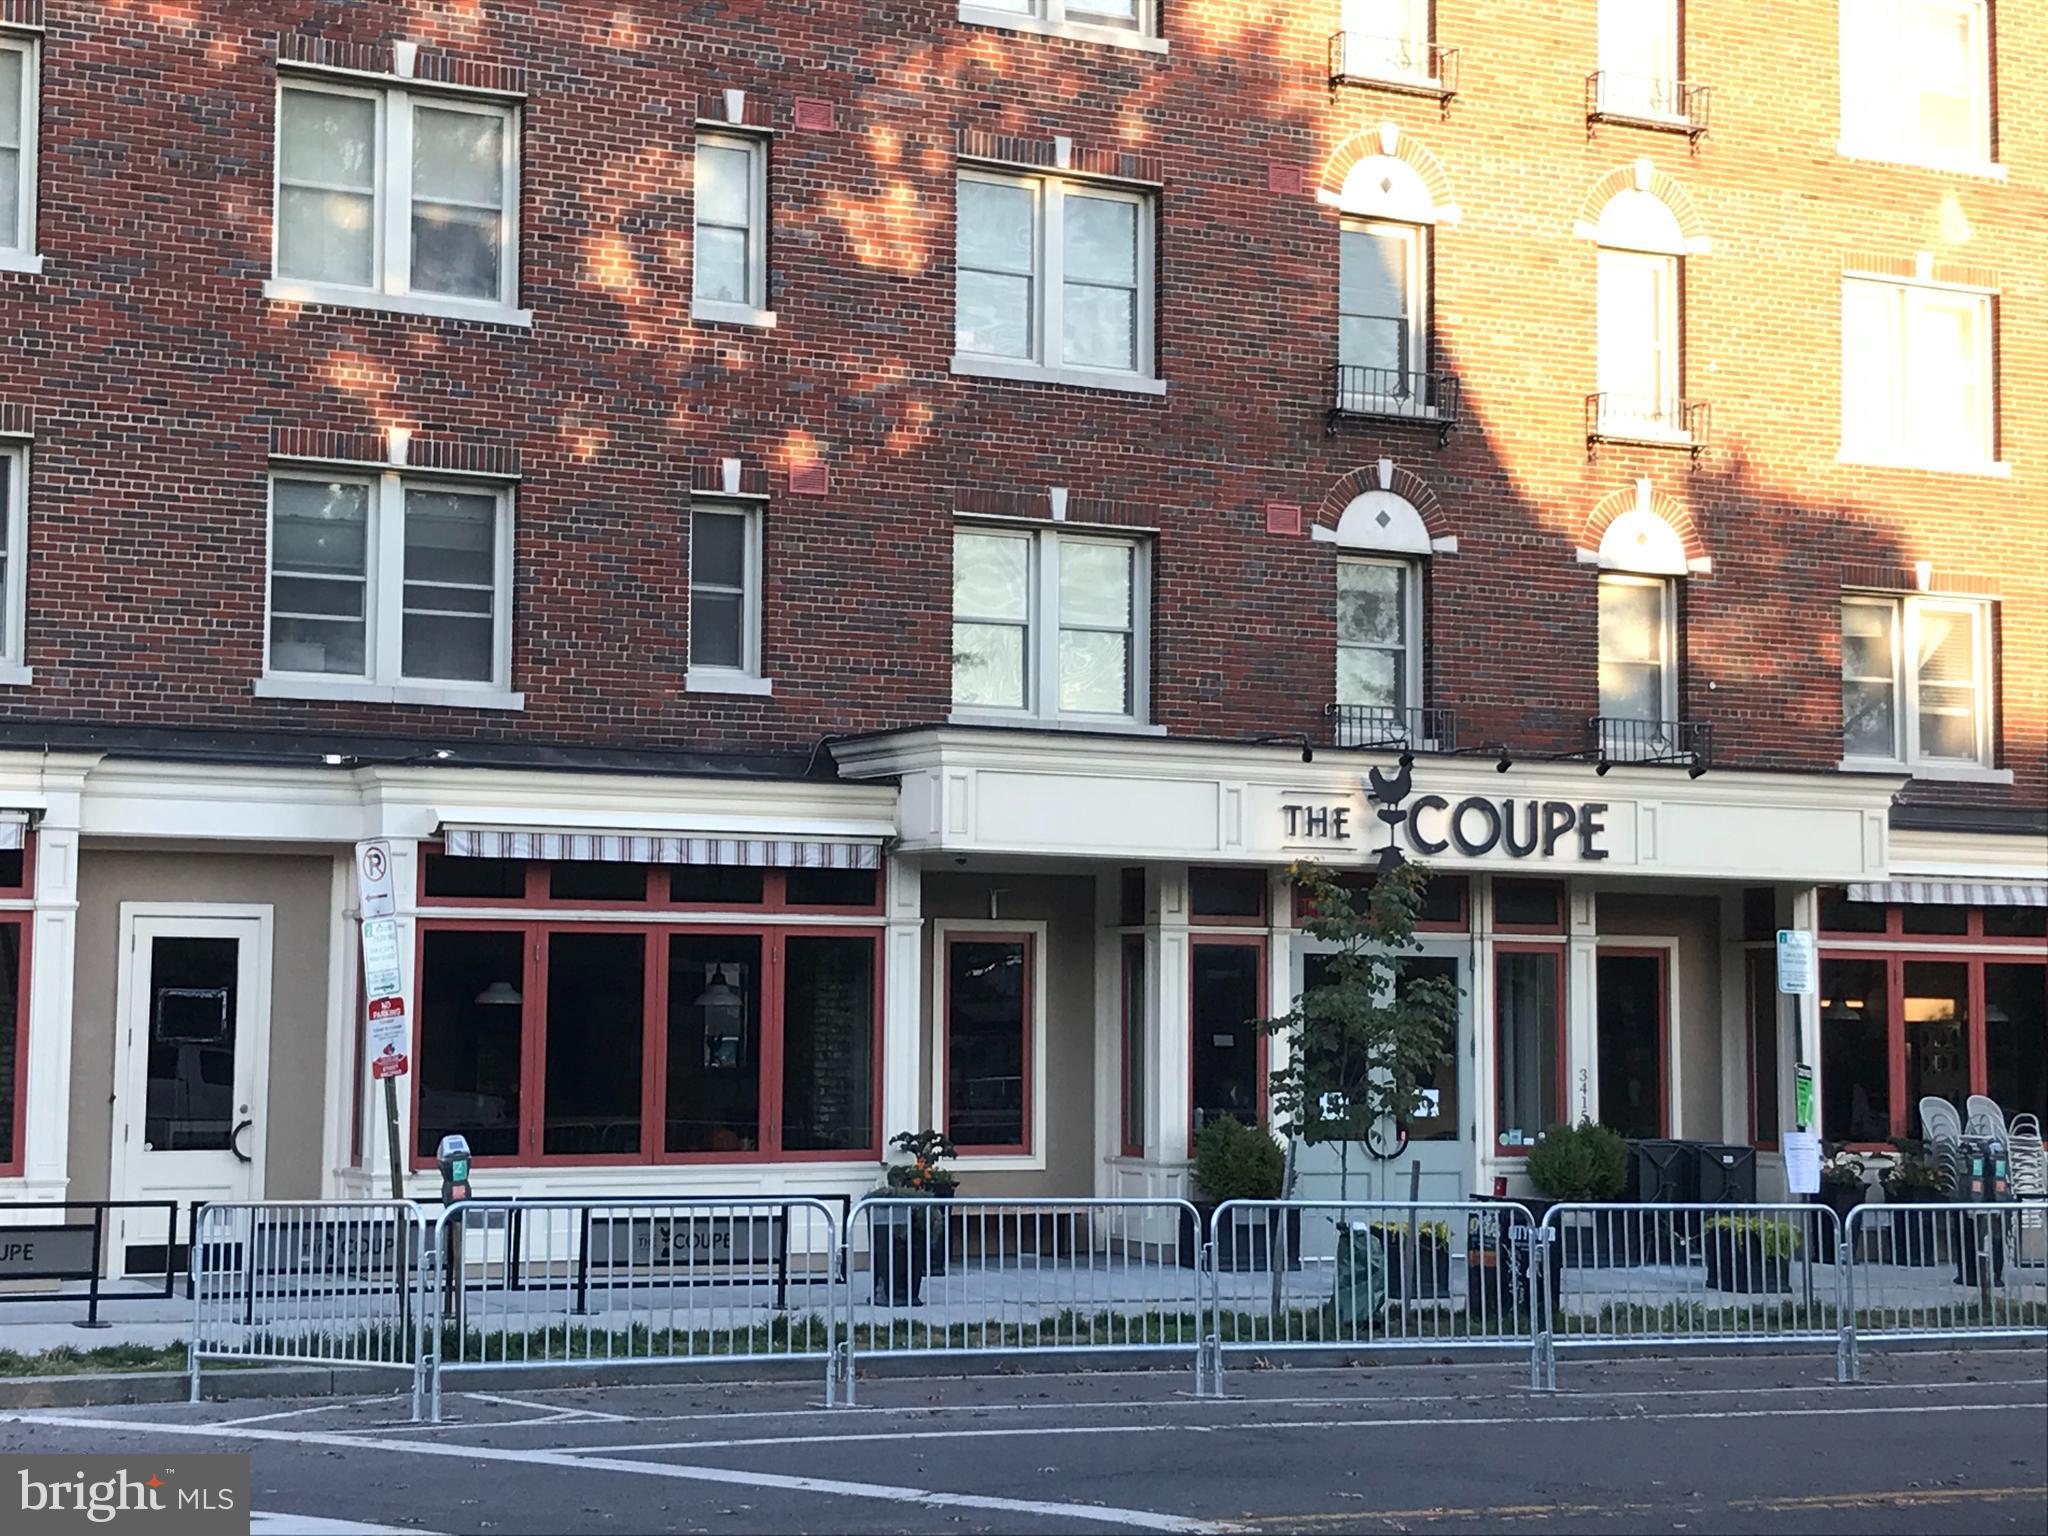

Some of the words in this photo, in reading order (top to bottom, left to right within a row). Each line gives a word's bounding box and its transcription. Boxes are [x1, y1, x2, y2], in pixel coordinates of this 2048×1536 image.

[1283, 805, 1350, 838] THE
[1408, 795, 1608, 859] COUPE
[373, 1008, 401, 1019] PARKING
[381, 1000, 391, 1010] NO
[341, 1238, 396, 1255] COUP
[638, 1237, 656, 1248] TH
[674, 1233, 732, 1250] COUPE
